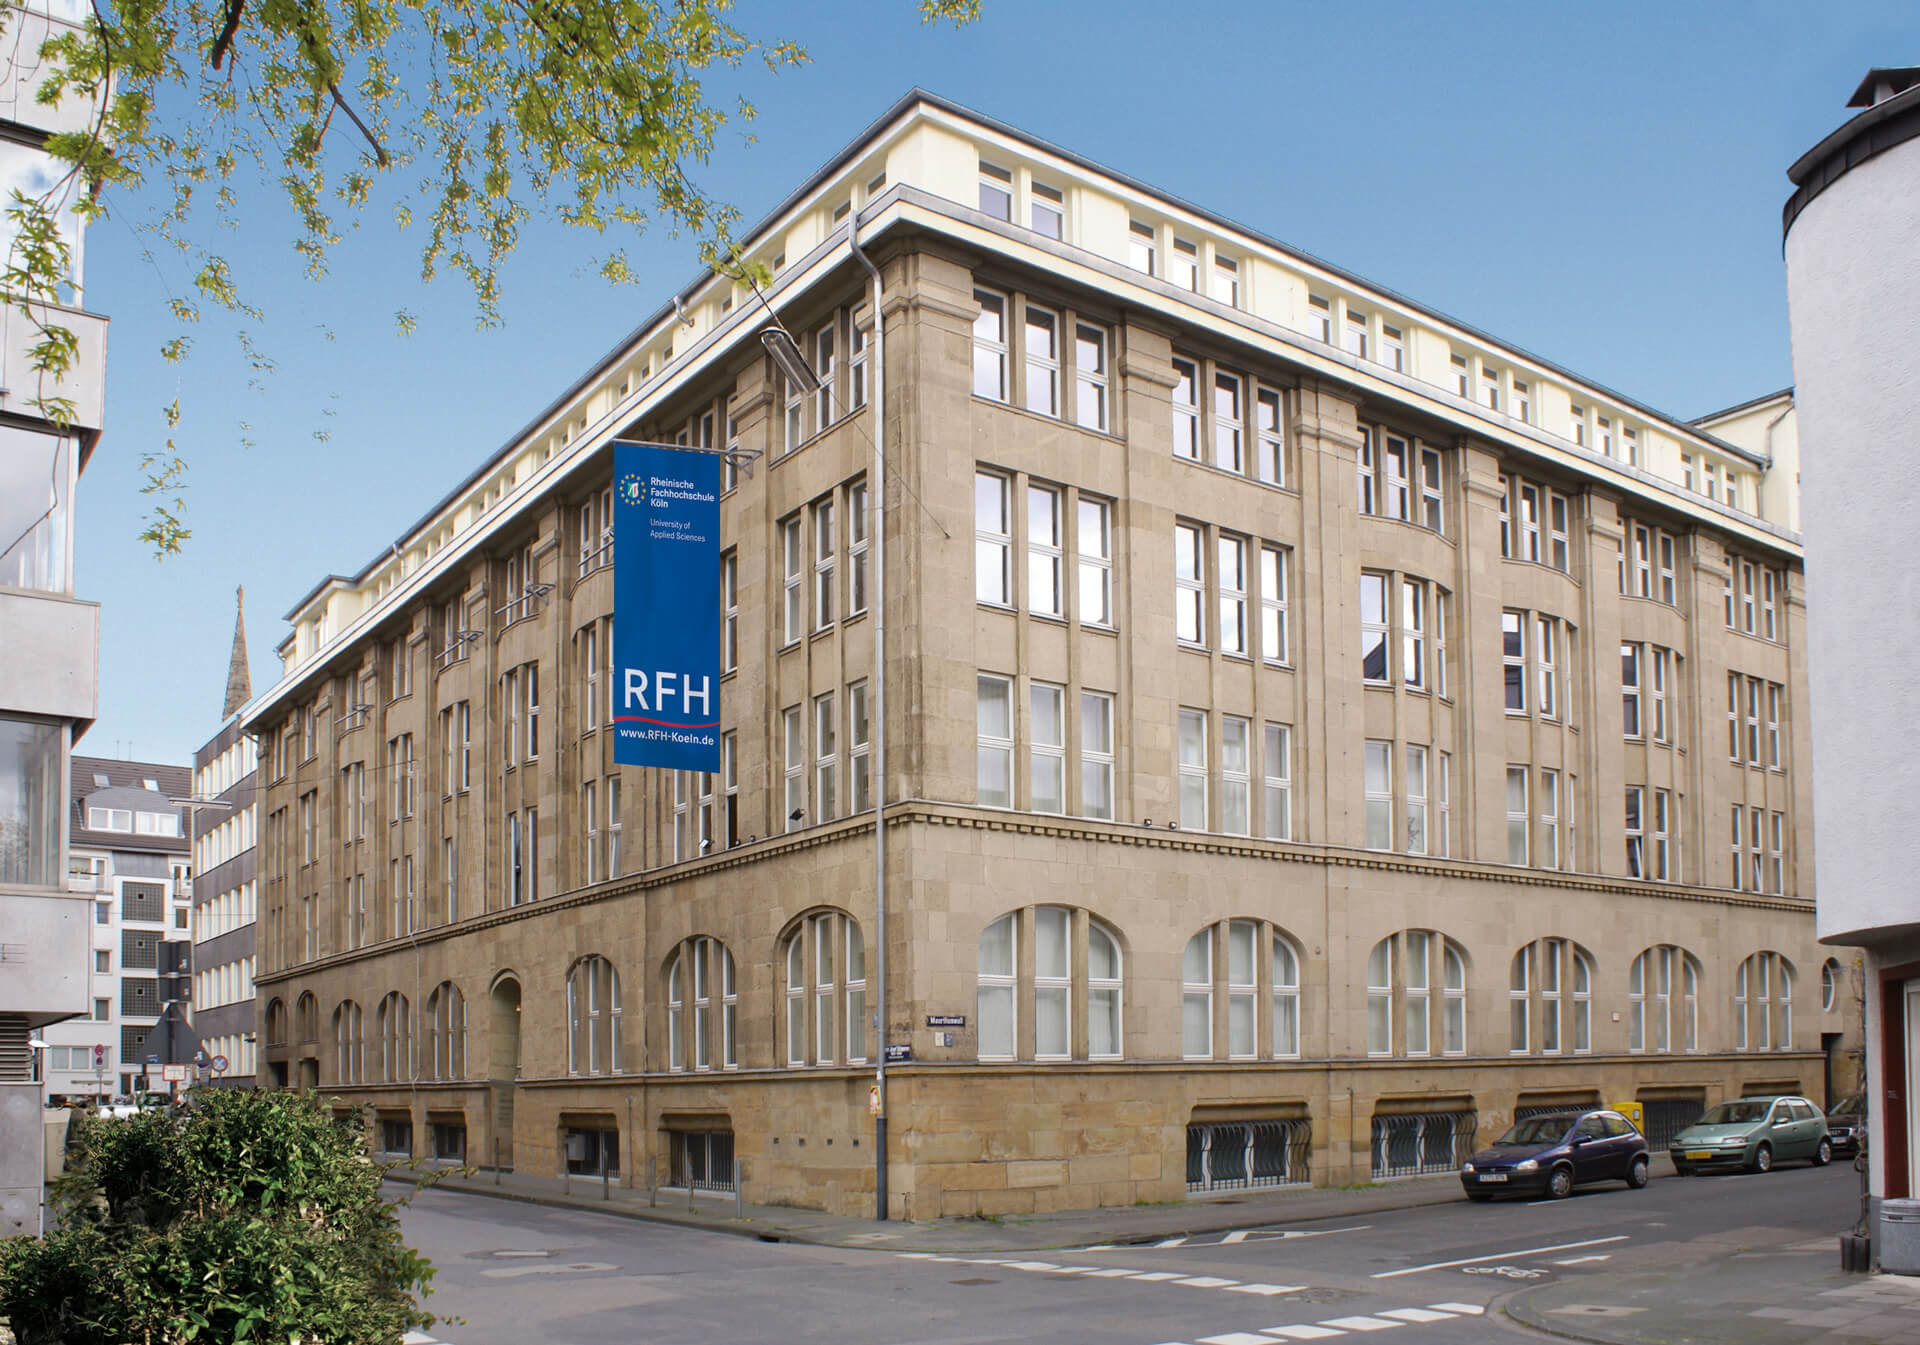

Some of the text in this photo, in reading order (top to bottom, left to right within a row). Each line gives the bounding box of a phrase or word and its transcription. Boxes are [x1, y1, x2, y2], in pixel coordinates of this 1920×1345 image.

[650, 477, 694, 489] Rheinische
[650, 488, 715, 502] Fachhochschule
[650, 498, 669, 508] Köln
[650, 519, 682, 530] University
[650, 530, 706, 542] Applied Sciences
[625, 668, 710, 716] RFH
[620, 729, 715, 745] www.RFH-Koeln.de
